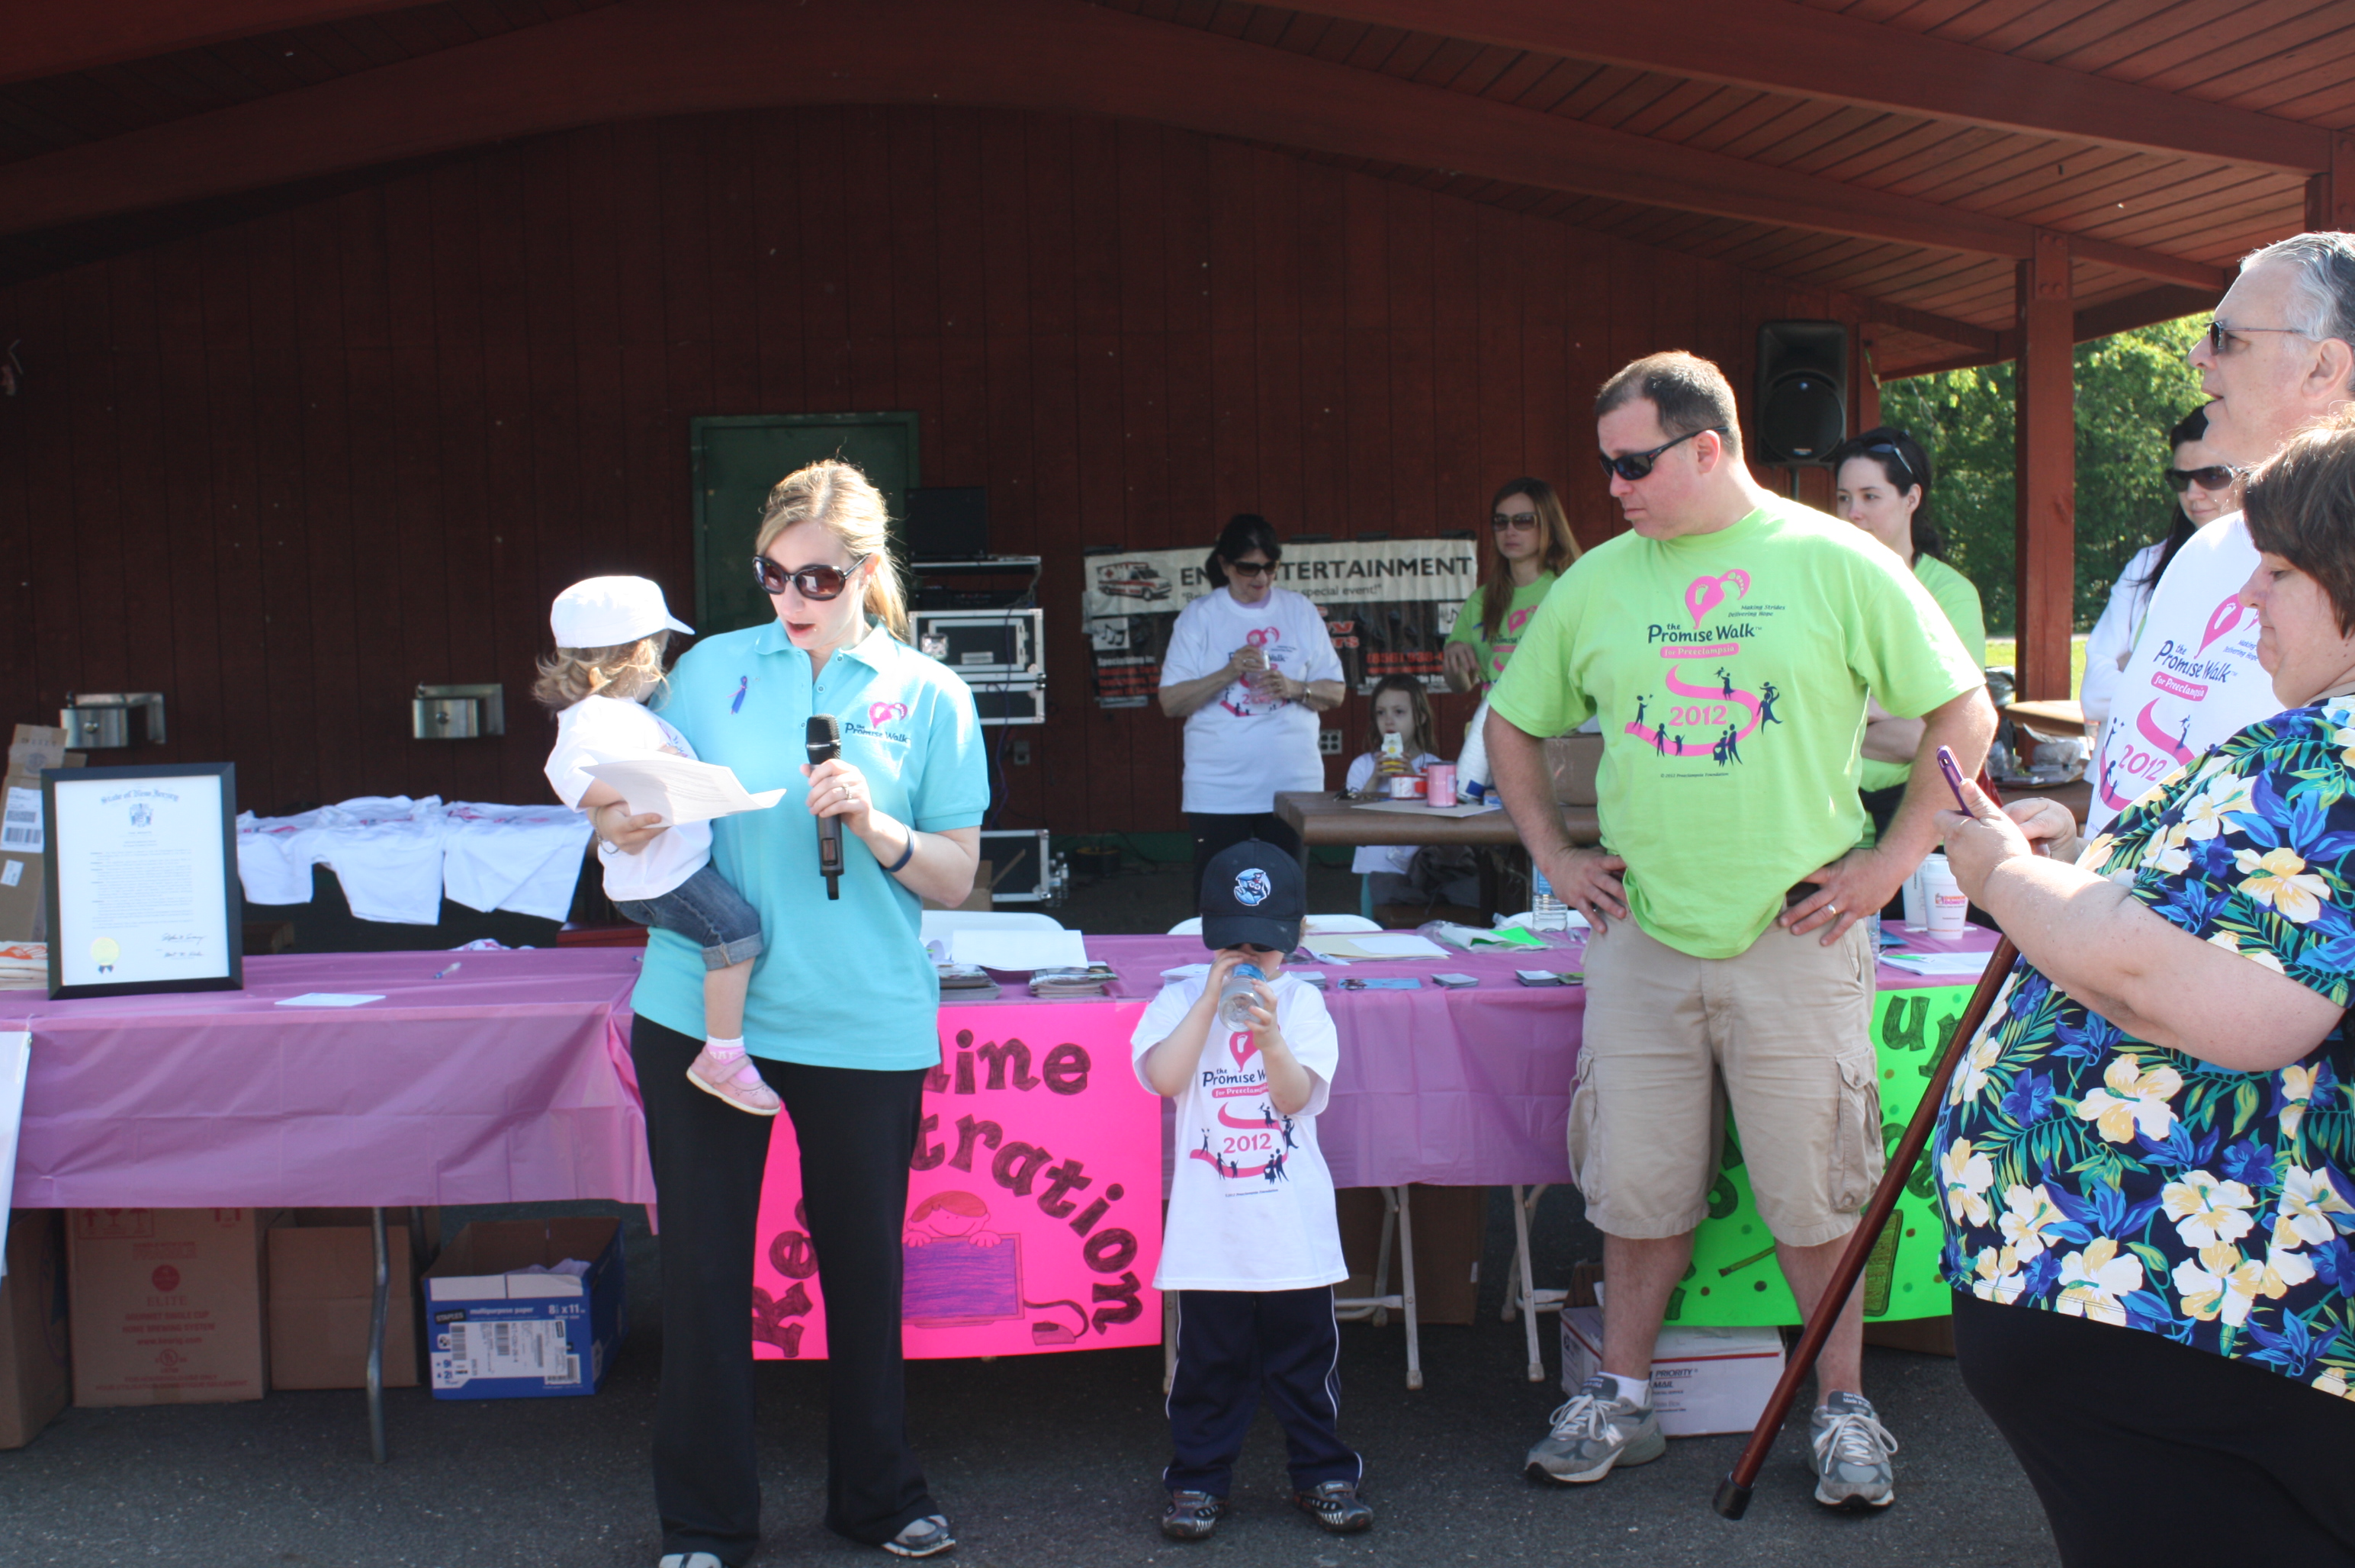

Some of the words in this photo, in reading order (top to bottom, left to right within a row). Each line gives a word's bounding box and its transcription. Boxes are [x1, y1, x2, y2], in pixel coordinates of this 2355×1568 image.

[1301, 584, 1338, 598] special
[1647, 624, 1713, 644] Promise
[1664, 648, 1676, 657] for
[1678, 644, 1736, 656] Preeclampsia
[2175, 644, 2188, 655] the
[2222, 646, 2247, 657] Delivering
[2153, 640, 2204, 678] Promise
[2154, 675, 2166, 685] for
[2165, 677, 2206, 699] Preeclampsia
[1668, 705, 1728, 727] 2012
[844, 722, 883, 737] Promise
[885, 731, 910, 744] Walk
[2118, 744, 2167, 782] 2012
[1202, 1071, 1256, 1088] Promise
[1222, 1133, 1273, 1154] 2012
[147, 1296, 188, 1307] ELITE
[194, 1310, 210, 1319] CUP
[470, 1307, 513, 1316] multipurpose
[568, 1303, 580, 1313] 11
[184, 1322, 216, 1331] SYSTEM
[1655, 1368, 1693, 1377] PRIORITY
[1653, 1380, 1674, 1389] MAIL
